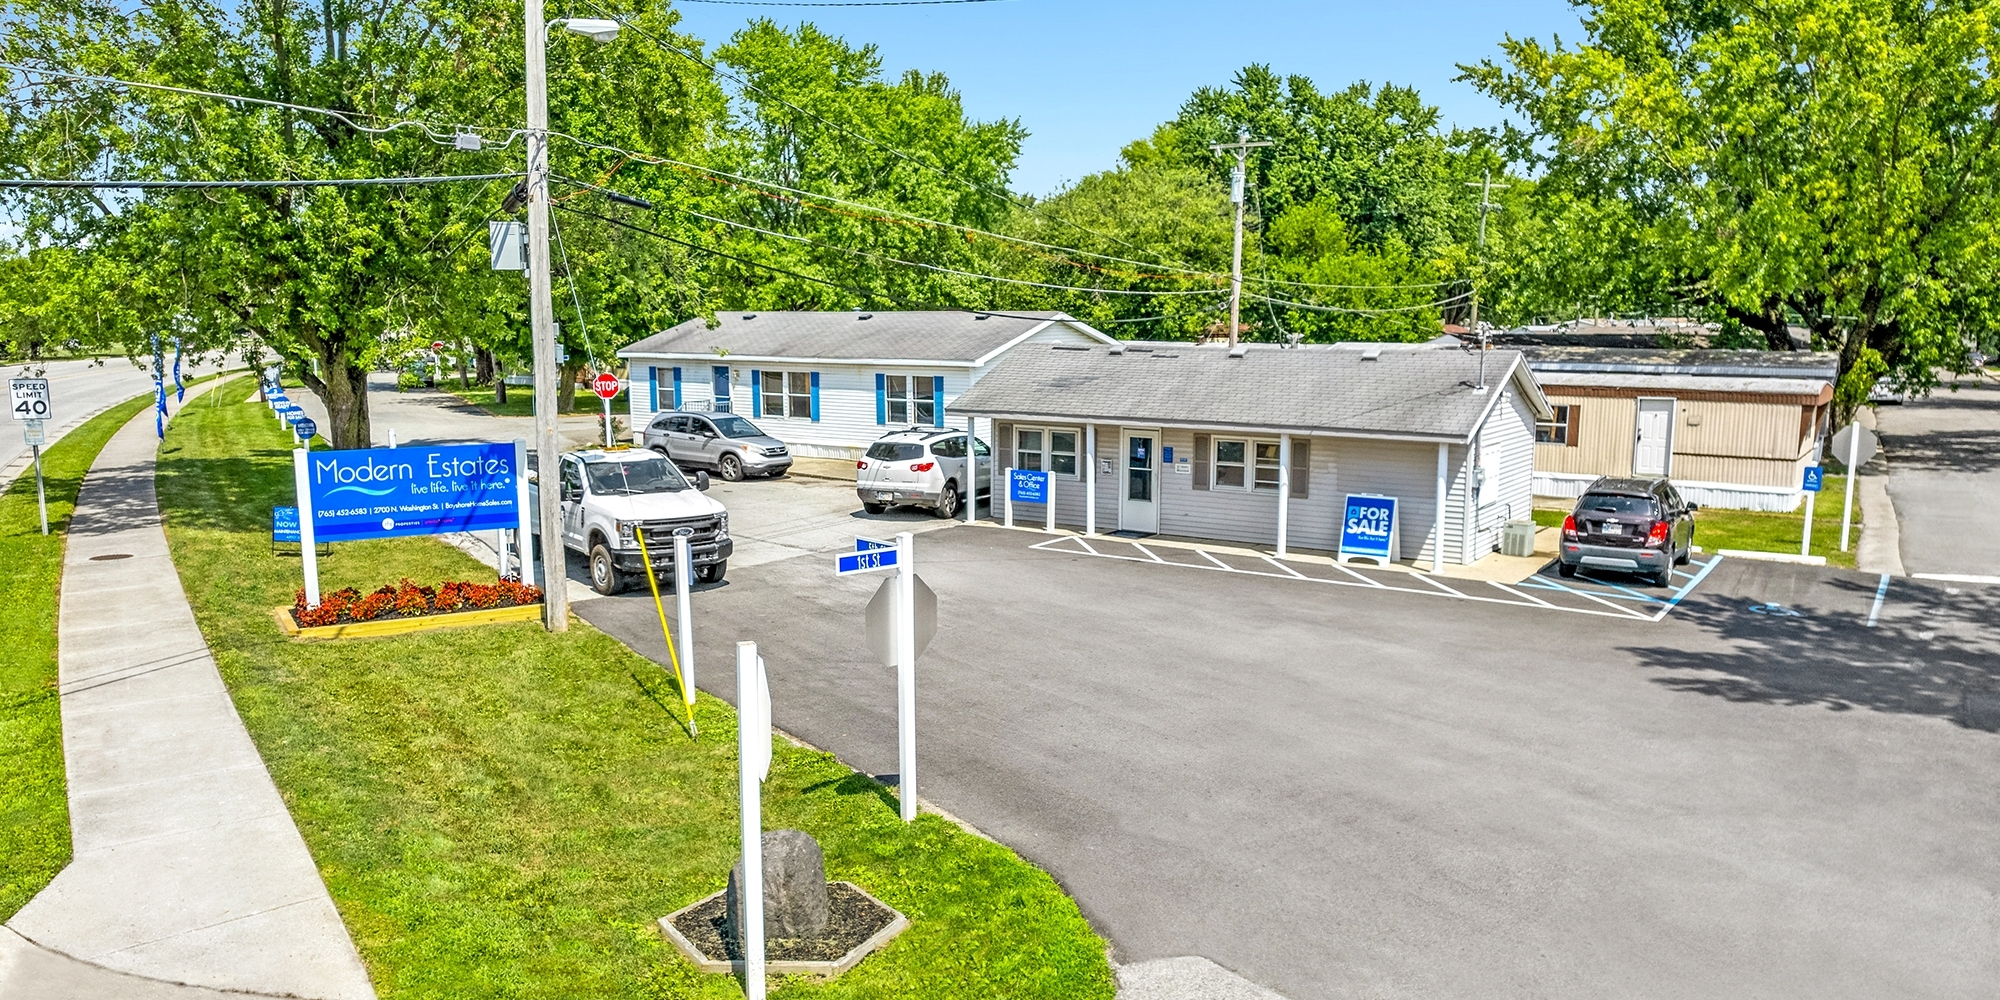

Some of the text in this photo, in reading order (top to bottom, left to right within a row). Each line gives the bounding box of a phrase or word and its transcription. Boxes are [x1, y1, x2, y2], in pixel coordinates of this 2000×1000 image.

[595, 381, 618, 391] STOP
[15, 400, 47, 415] 40
[316, 453, 509, 484] Modern Estates
[1013, 472, 1045, 482] Sales Center
[411, 482, 428, 494] live
[430, 481, 449, 493] life.
[452, 480, 468, 492] live
[471, 481, 478, 490] it
[1023, 480, 1040, 489] Office
[318, 510, 334, 518] (765)
[336, 507, 367, 516] 452-6583
[373, 505, 391, 514] 2700
[391, 504, 398, 512] N.
[399, 502, 431, 512] Washington
[445, 499, 513, 509] BayshoreHomeSales.com
[1360, 506, 1390, 520] FOR
[1346, 518, 1389, 537] SALE
[857, 552, 880, 570] 1st St
